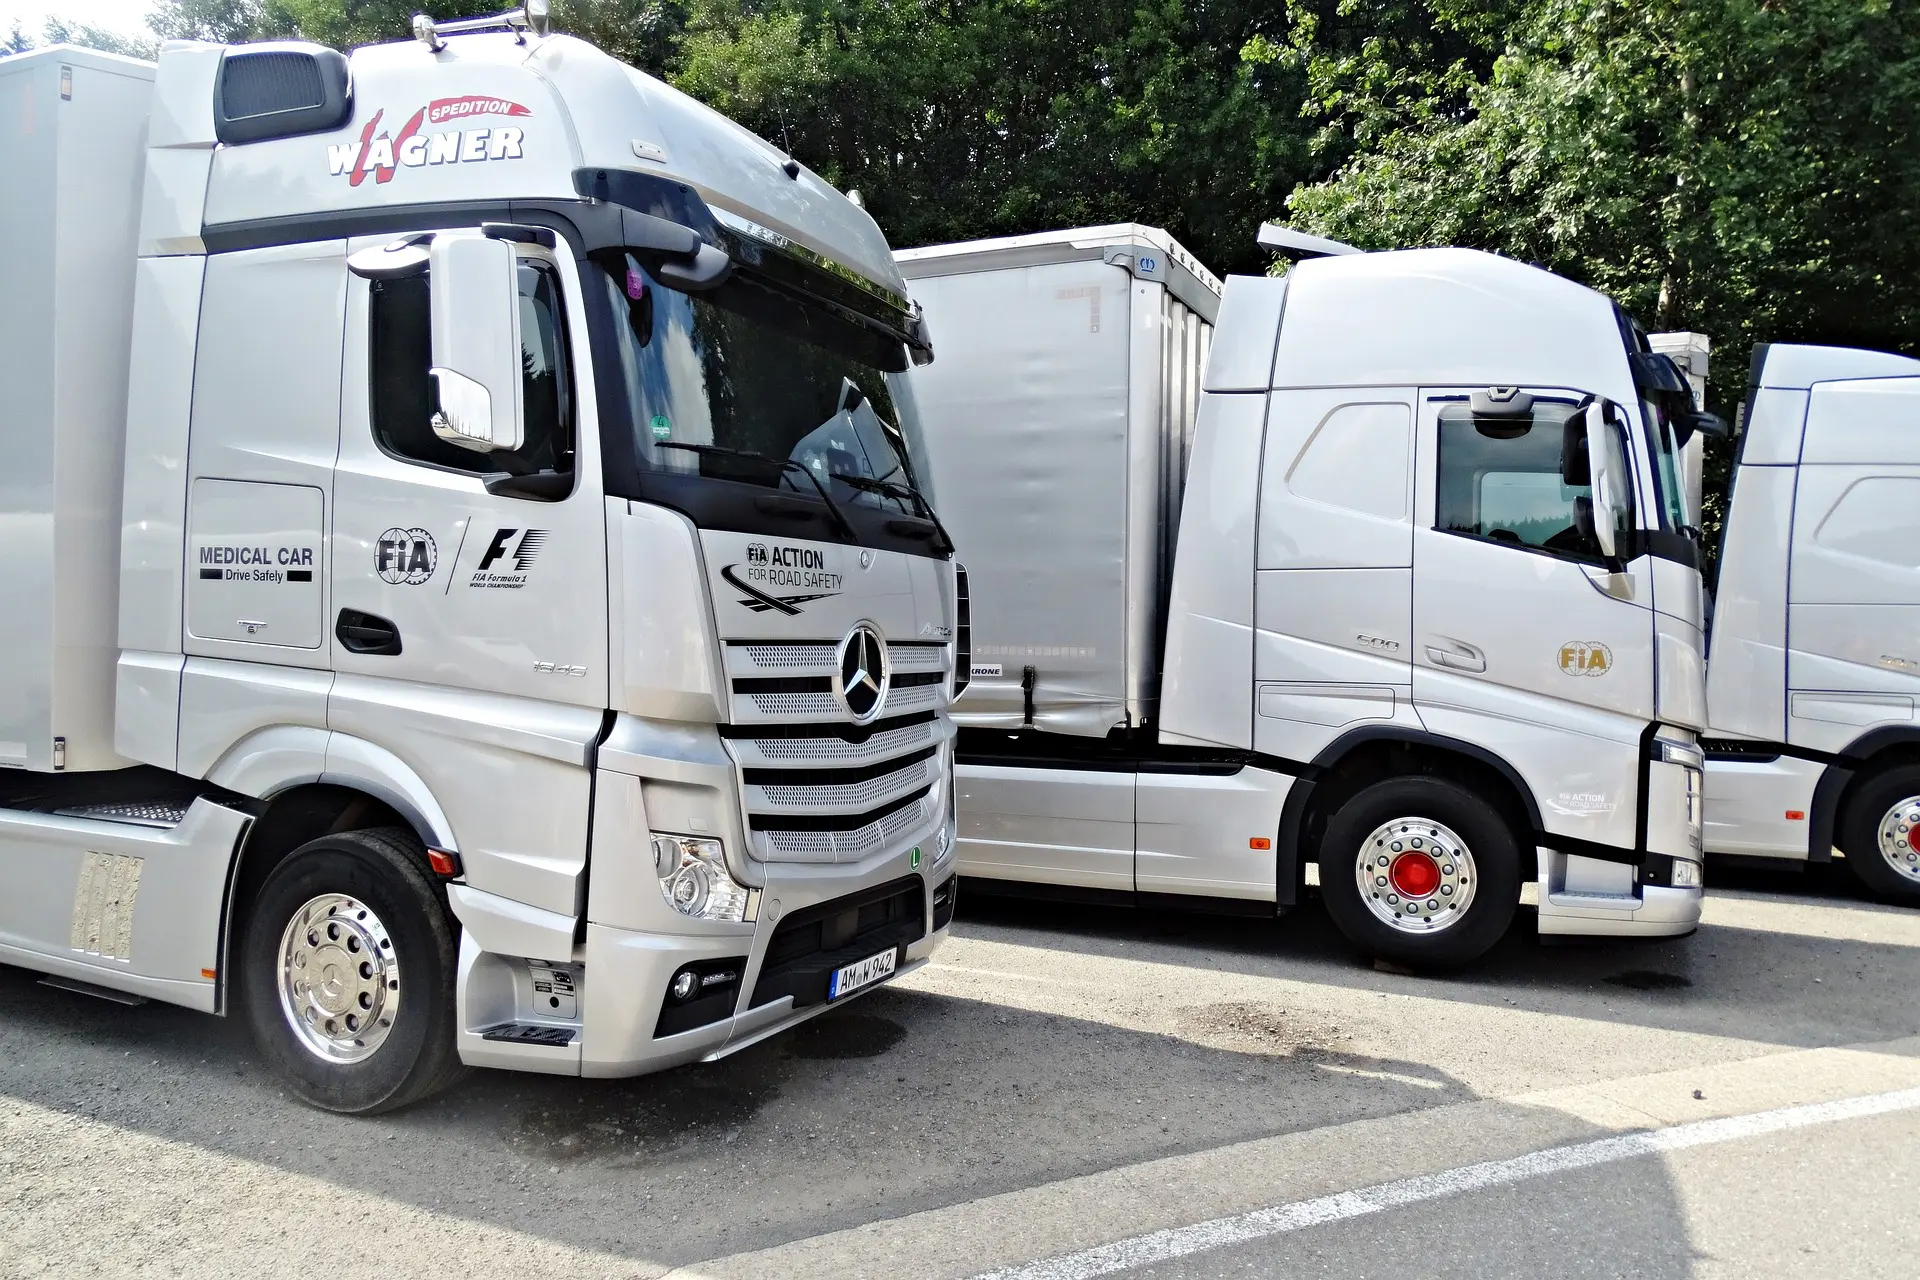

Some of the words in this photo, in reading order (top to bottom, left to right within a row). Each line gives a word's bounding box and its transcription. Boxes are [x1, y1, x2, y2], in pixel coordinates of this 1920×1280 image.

[431, 100, 512, 121] SPEDITION
[327, 126, 525, 176] WAGNER
[200, 547, 273, 565] MEDICAL
[277, 547, 313, 566] CAR
[772, 546, 824, 570] ACTION
[226, 569, 251, 581] Drive
[253, 569, 283, 584] Safely
[488, 574, 520, 583] Formula
[748, 568, 767, 581] FOR
[769, 569, 802, 587] ROAD
[804, 571, 843, 589] SAFETY
[1572, 794, 1604, 802] ACTION
[912, 849, 919, 867] L
[840, 966, 857, 991] AM
[863, 961, 871, 982] W
[872, 952, 892, 978] 942
